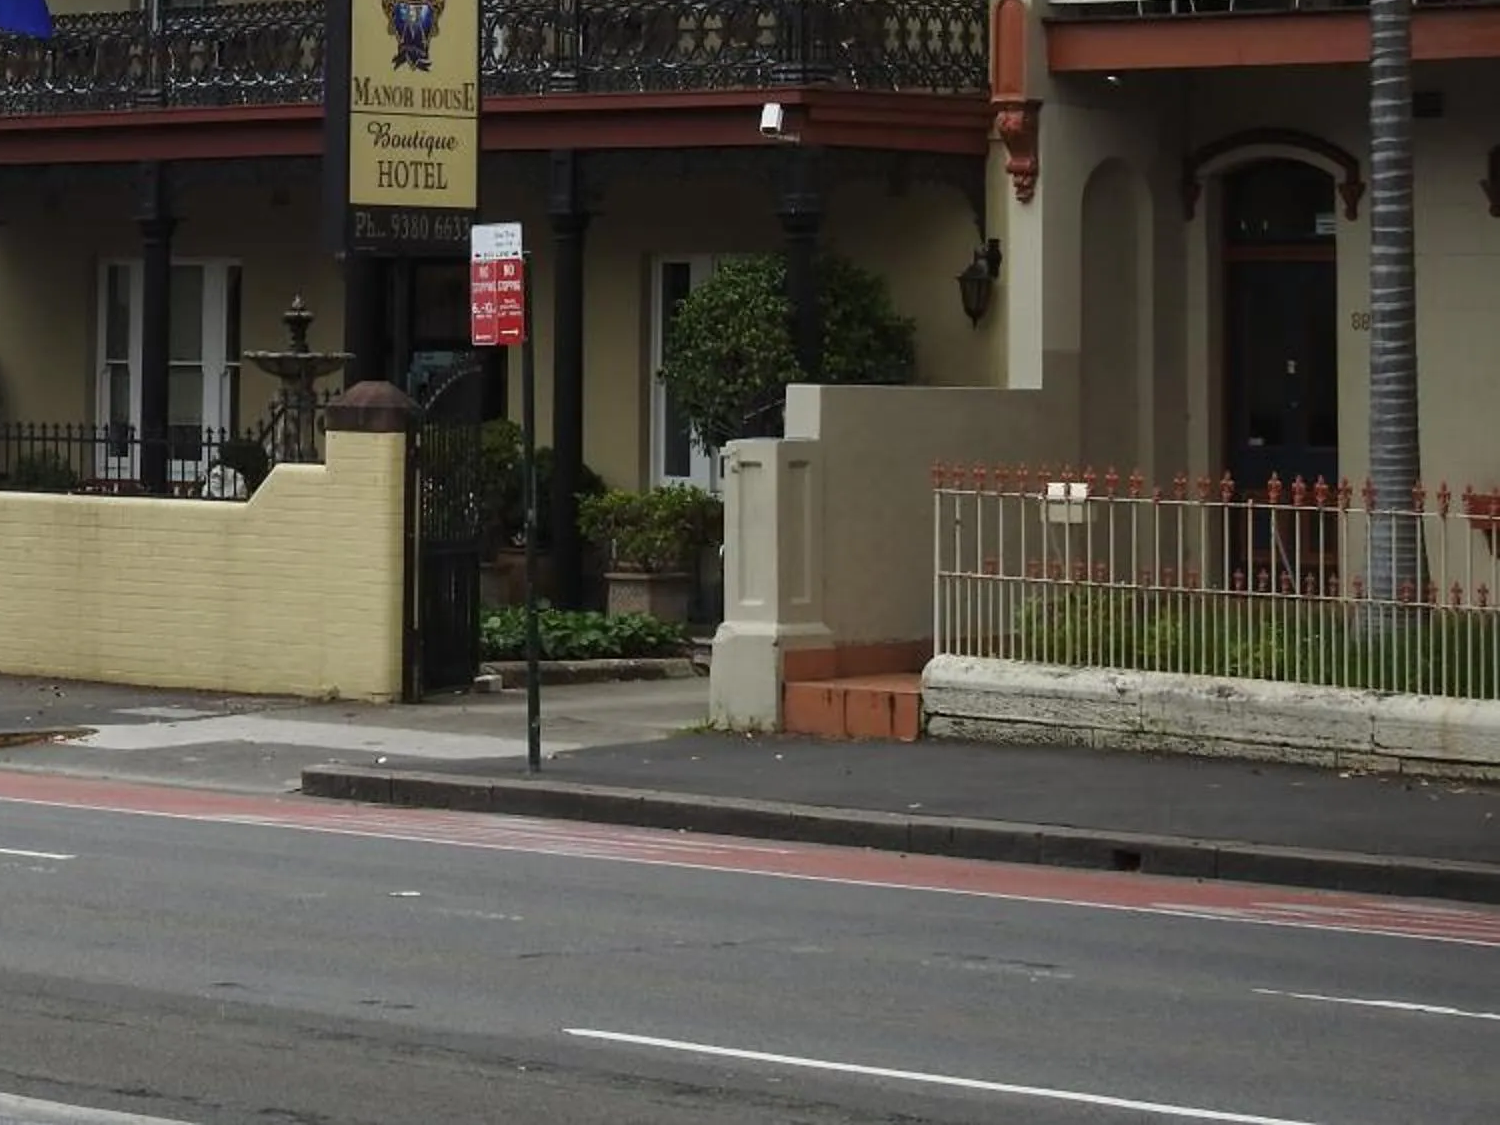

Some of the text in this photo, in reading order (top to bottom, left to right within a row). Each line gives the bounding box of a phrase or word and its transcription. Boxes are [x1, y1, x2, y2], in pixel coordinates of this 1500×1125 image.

[354, 76, 476, 111] MANOR HOUSE
[367, 121, 459, 158] Boutique
[377, 160, 448, 190] HOTEL
